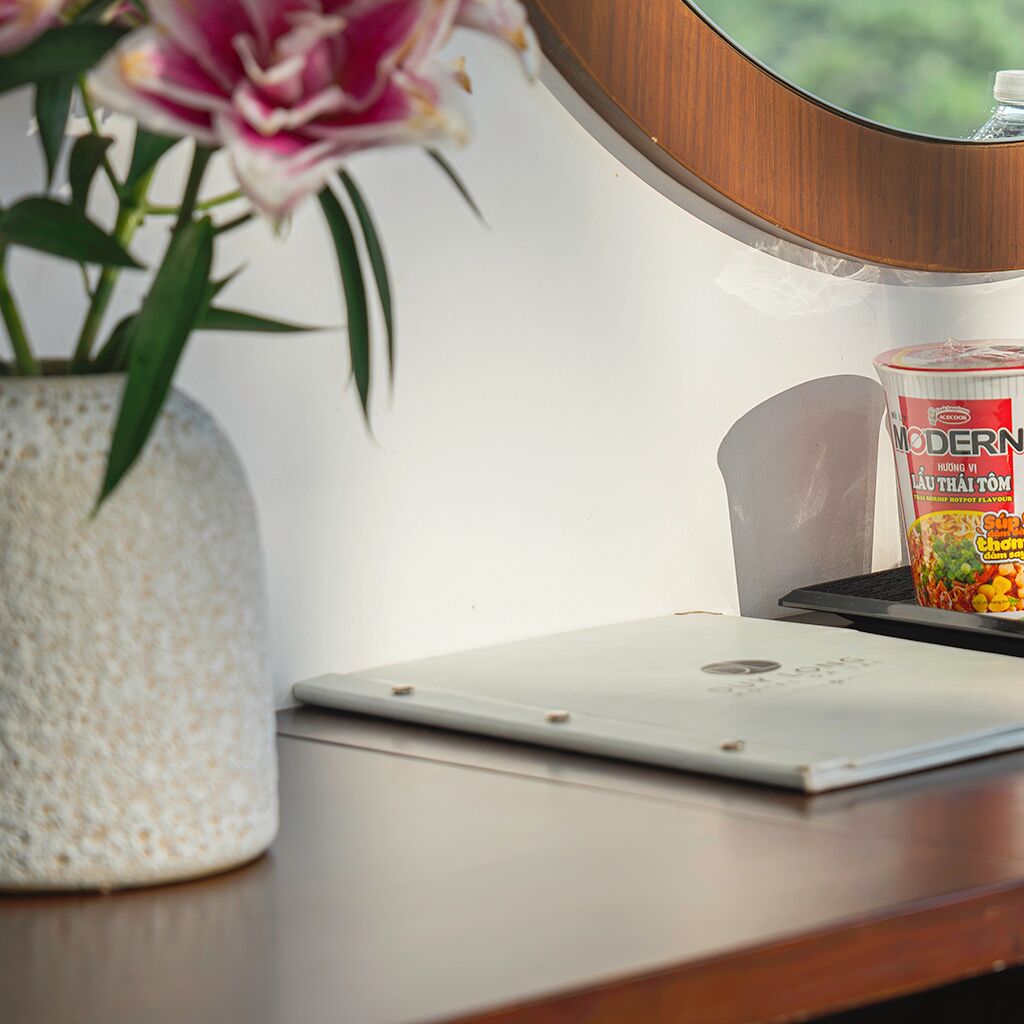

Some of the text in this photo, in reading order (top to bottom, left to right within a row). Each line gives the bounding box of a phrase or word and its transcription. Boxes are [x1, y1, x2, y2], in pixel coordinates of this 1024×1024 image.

[893, 423, 1024, 455] MODERN
[911, 466, 1012, 493] LẨU THÁI TÔM
[926, 495, 949, 503] SHRIMP
[949, 496, 977, 504] HOTPOT
[978, 495, 1013, 504] FLAVOUR
[983, 512, 1020, 533] Súp
